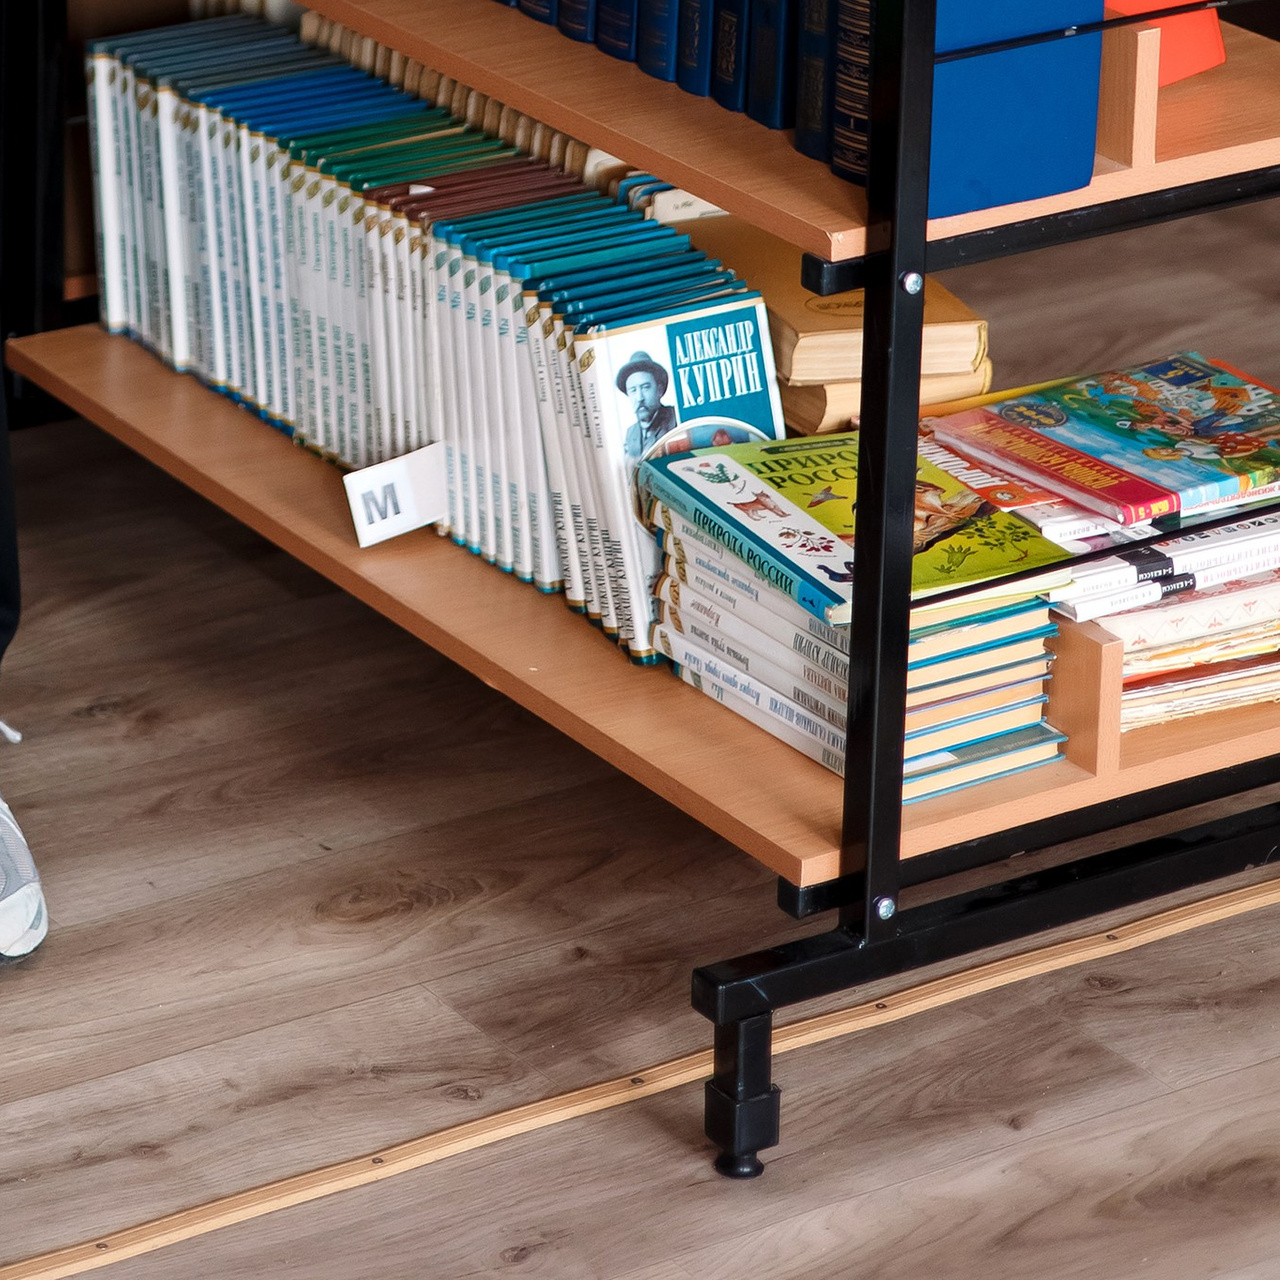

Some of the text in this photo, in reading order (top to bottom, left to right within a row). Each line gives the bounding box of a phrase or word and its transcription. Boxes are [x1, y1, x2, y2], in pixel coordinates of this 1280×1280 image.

[437, 284, 446, 303] Мы
[451, 291, 461, 310] Мы
[466, 302, 476, 322] Мы
[482, 309, 492, 327] Мы
[499, 318, 509, 337] Мы
[516, 326, 527, 346] Мы
[674, 320, 754, 366] АЛЕКСАНДР
[677, 352, 764, 409] КУПРИН
[1063, 459, 1118, 489] ОСНОВЫ
[361, 482, 400, 525] М
[553, 492, 565, 531] КУПРИН
[1138, 498, 1170, 520] ОБЖ 5
[571, 504, 585, 543] КУПРИН
[587, 518, 601, 557] КУПРИН
[601, 529, 616, 568] КУПРИН
[612, 540, 626, 580] КУПРИН
[694, 507, 795, 595] ПРИРОДА РОССИИ
[793, 632, 822, 666] КУПРИН
[711, 683, 724, 701] Мы
